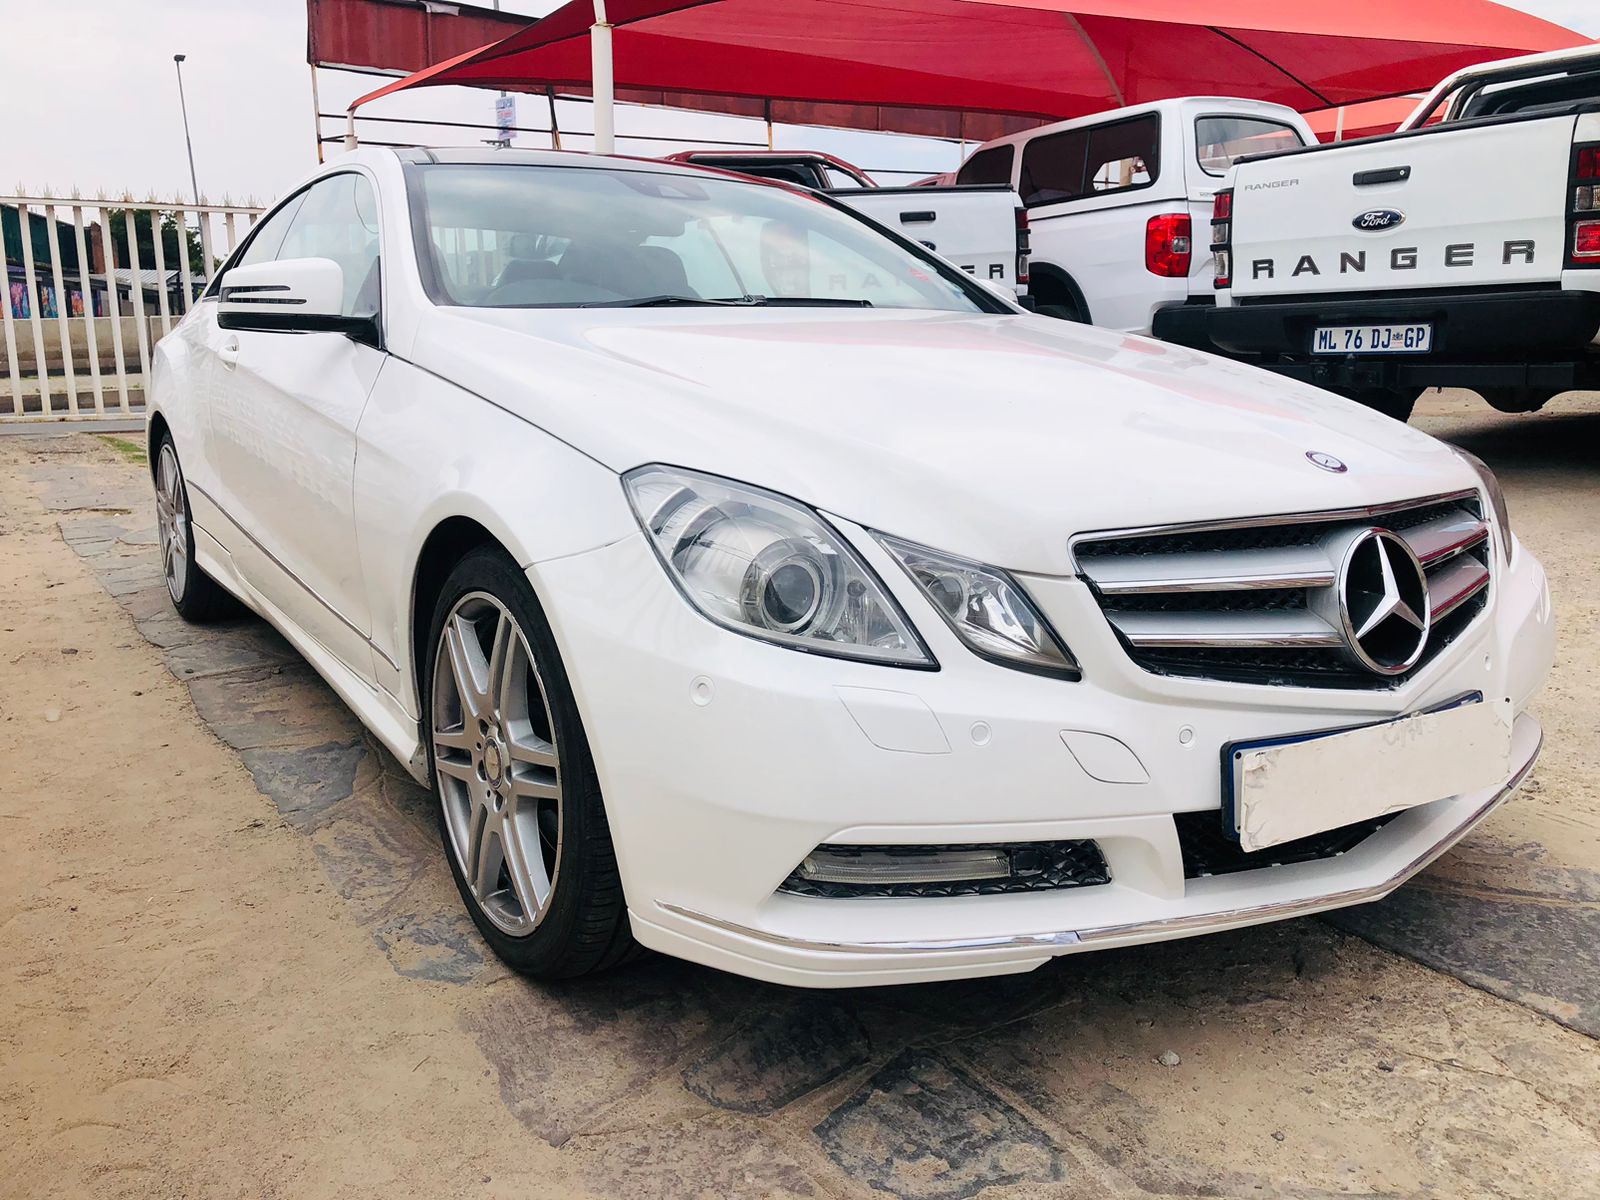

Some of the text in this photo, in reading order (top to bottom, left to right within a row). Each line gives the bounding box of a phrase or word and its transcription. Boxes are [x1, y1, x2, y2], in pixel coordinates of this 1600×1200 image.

[1244, 178, 1300, 191] RANGER
[1360, 211, 1391, 227] Ford
[1252, 239, 1536, 279] RANGER
[1317, 327, 1426, 350] ML 76 DJ GP
